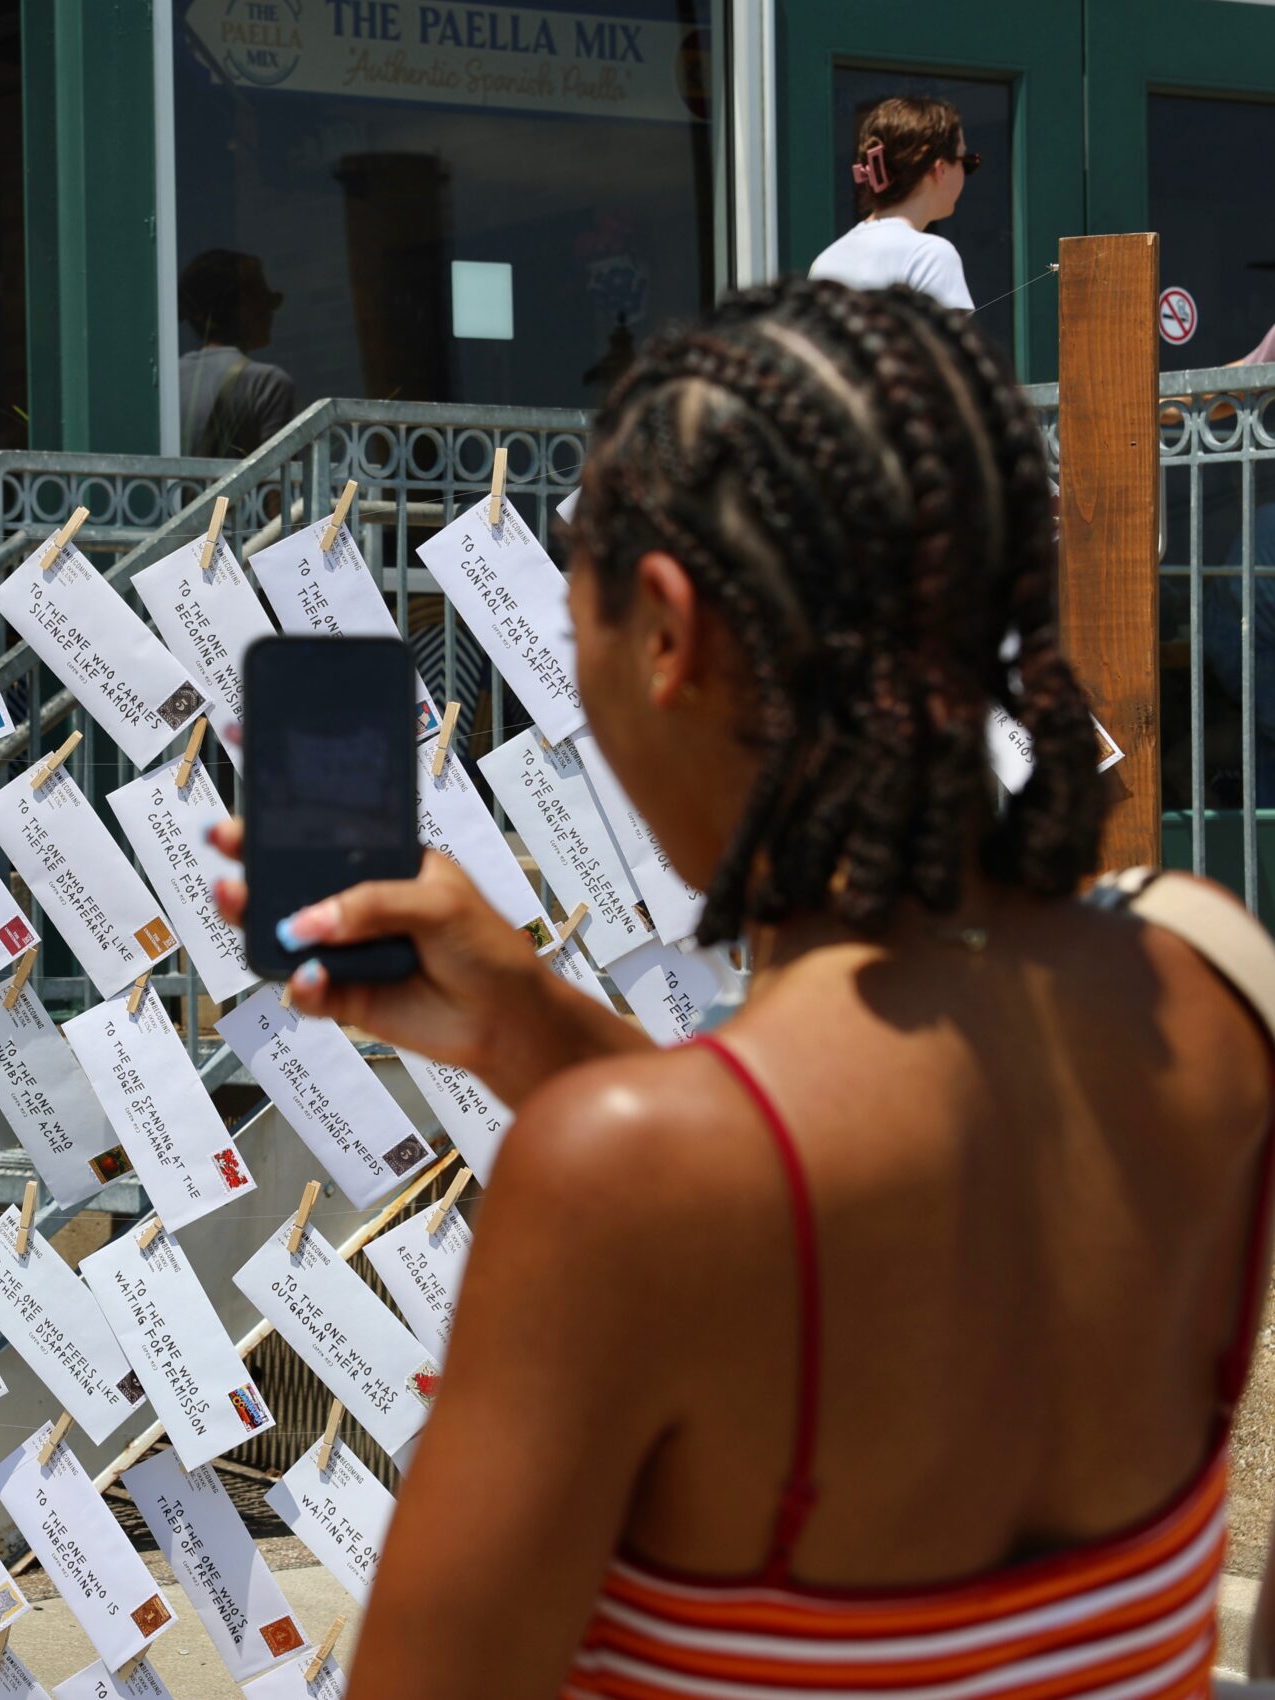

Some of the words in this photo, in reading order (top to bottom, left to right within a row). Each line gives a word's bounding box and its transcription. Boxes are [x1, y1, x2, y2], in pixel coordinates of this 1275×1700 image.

[220, 19, 303, 49] PAELLA
[245, 2, 279, 21] THE
[324, 0, 401, 41] THE
[419, 5, 556, 55] PAELLA
[575, 20, 645, 63] MIX
[246, 49, 279, 68] MIX
[465, 56, 553, 102] Spanish
[502, 508, 530, 545] UNBECOMING
[460, 560, 500, 615] CONTROL
[499, 616, 522, 645] FOR
[521, 646, 563, 699] SAFETY
[461, 534, 474, 552] TO
[474, 555, 497, 582] THE
[494, 586, 518, 611] ONE
[516, 615, 538, 644] WHO
[538, 647, 582, 709] MISTAKES
[54, 771, 80, 807] UNBECOMING
[17, 798, 29, 814] TO
[29, 816, 48, 839] THE
[46, 843, 66, 865] ONE
[65, 868, 84, 894] WHO
[82, 895, 114, 934] FEELS
[111, 935, 134, 961] LIKE
[520, 770, 533, 786] TO
[530, 788, 568, 841] FORGIVE
[565, 845, 618, 924] THEMSELVES
[522, 748, 535, 765] TO
[533, 768, 553, 794] THE
[550, 799, 571, 822] ONE
[568, 826, 588, 854] WHO
[586, 857, 600, 870] IS
[595, 873, 635, 934] LEARNING
[21, 824, 57, 871] THEY'RE
[55, 873, 109, 950] DISAPPEARING
[20, 993, 44, 1029] UNBECOMING
[665, 971, 679, 989] TO
[4, 1039, 17, 1056] TO
[16, 1060, 37, 1086] THE
[33, 1092, 55, 1115] ONE
[52, 1120, 73, 1149] WHO
[20, 1089, 41, 1115] THE
[37, 1121, 64, 1153] ACHE
[258, 1014, 269, 1030] TO
[270, 1032, 290, 1054] THE
[289, 1058, 309, 1079] ONE
[309, 1083, 329, 1107] WHO
[329, 1112, 353, 1135] JUST
[351, 1139, 383, 1175] NEEDS
[269, 1051, 279, 1061] A
[278, 1061, 307, 1098] SMALL
[307, 1099, 350, 1153] REMINDER
[302, 1231, 331, 1266] UNBECOMING
[114, 1269, 147, 1326] WAITING
[143, 1327, 164, 1357] FOR
[161, 1360, 206, 1436] PERMISSION
[134, 1278, 146, 1296] TO
[144, 1300, 165, 1328] THE
[161, 1334, 182, 1359] ONE
[178, 1364, 198, 1395] WHO
[195, 1399, 209, 1413] IS
[271, 1281, 326, 1342] OUTGROWN
[327, 1343, 358, 1381] THEIR
[361, 1381, 391, 1414] MASK
[284, 1274, 297, 1292] TO
[300, 1293, 323, 1319] THE
[323, 1322, 347, 1345] ONE
[348, 1348, 372, 1376] WHO
[374, 1378, 398, 1402] HAS
[333, 1450, 364, 1485] UNBECOMING
[35, 1488, 47, 1506] TO
[47, 1509, 68, 1535] THE
[66, 1540, 87, 1565] ONE
[86, 1569, 106, 1598] WHO
[106, 1601, 119, 1615] IS
[41, 1520, 93, 1598] UNBECOMING
[301, 1494, 344, 1544] WAITING
[345, 1543, 369, 1571] FOR
[323, 1497, 336, 1516] TO
[339, 1517, 363, 1543] THE
